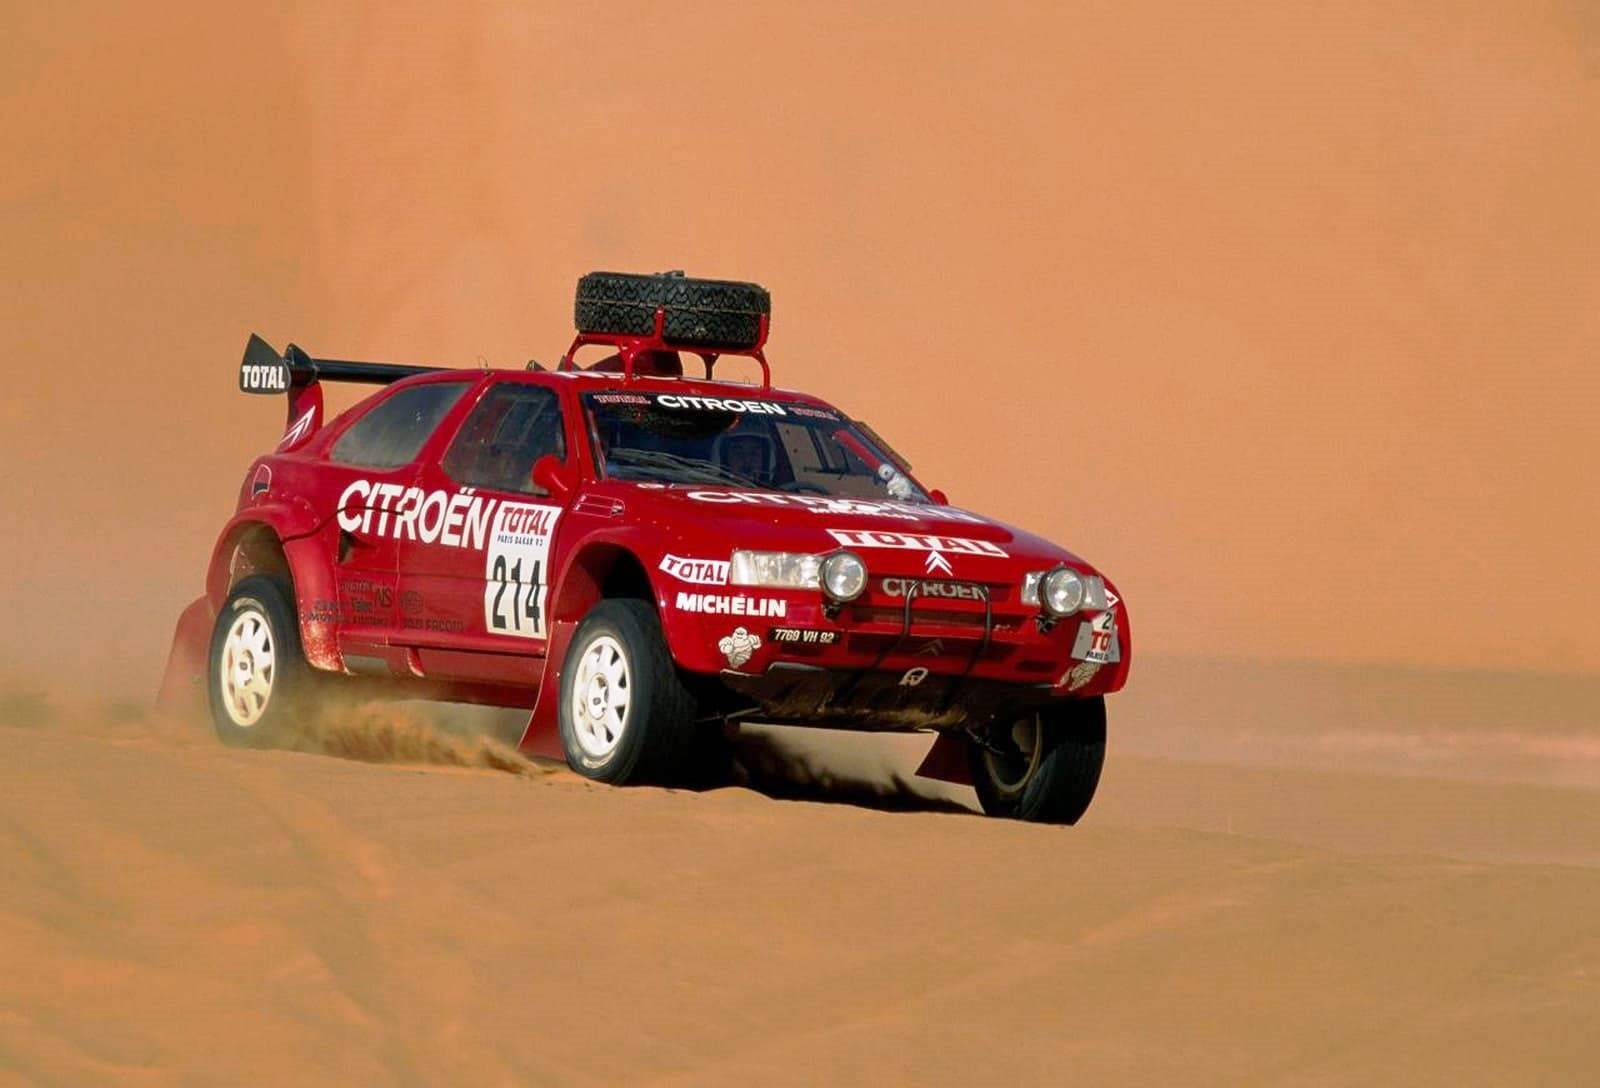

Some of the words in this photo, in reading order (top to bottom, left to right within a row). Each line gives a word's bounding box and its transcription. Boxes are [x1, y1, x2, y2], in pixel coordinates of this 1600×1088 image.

[242, 365, 285, 389] TOTAL
[337, 479, 497, 550] CITROËN
[501, 506, 551, 536] TOTAL
[497, 534, 513, 544] PARIS
[514, 536, 533, 546] DAKAR
[832, 531, 1007, 556] TOTAL
[667, 557, 725, 583] TOTAL
[492, 554, 541, 633] 214
[676, 592, 787, 617] MICHELIN
[803, 630, 818, 643] VH
[820, 631, 834, 644] 92
[1091, 631, 1113, 652] TO
